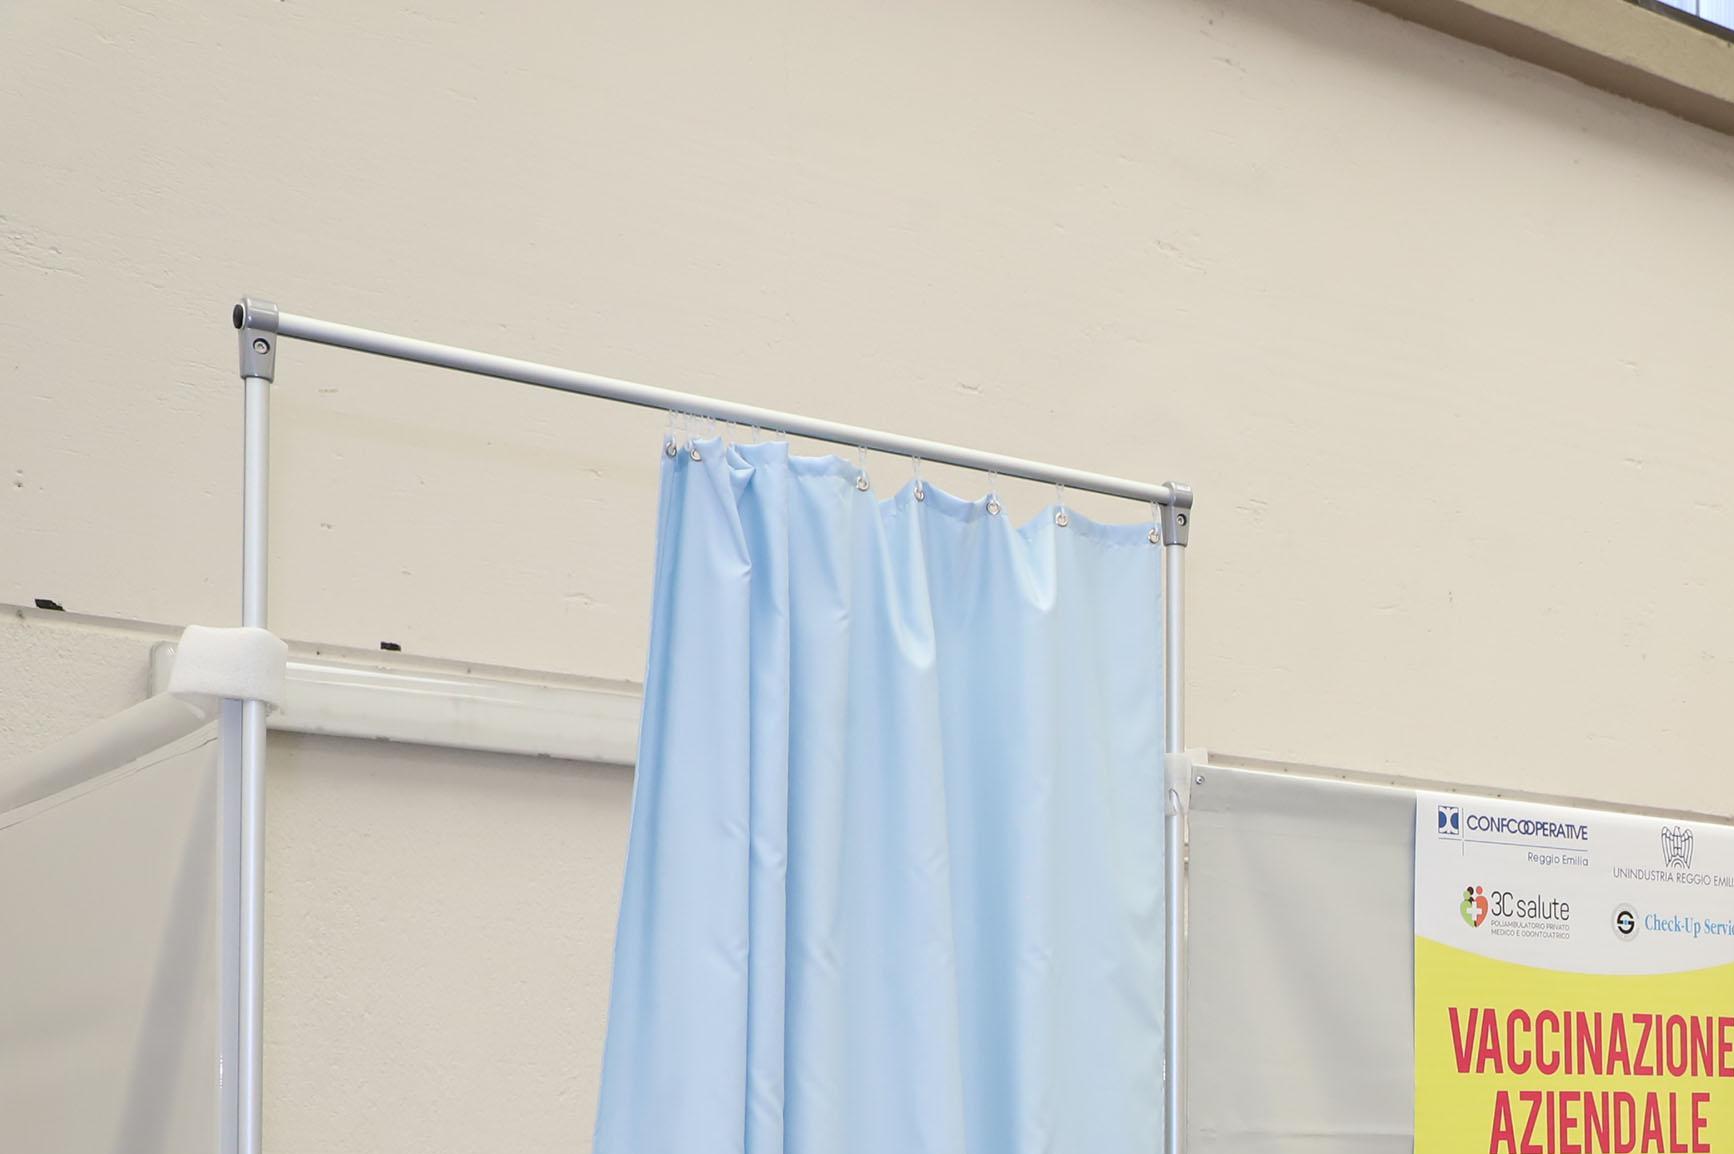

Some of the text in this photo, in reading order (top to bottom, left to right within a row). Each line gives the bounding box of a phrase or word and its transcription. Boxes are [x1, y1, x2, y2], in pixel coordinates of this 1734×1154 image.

[1466, 814, 1588, 841] CONFCOOPERATIVE
[1528, 851, 1589, 867] Reggio Emilia
[1613, 867, 1674, 883] UNINDUSTRIA
[1676, 872, 1711, 887] REGGIO
[1491, 890, 1570, 921] 3C salute
[1644, 913, 1701, 939] Check-Up
